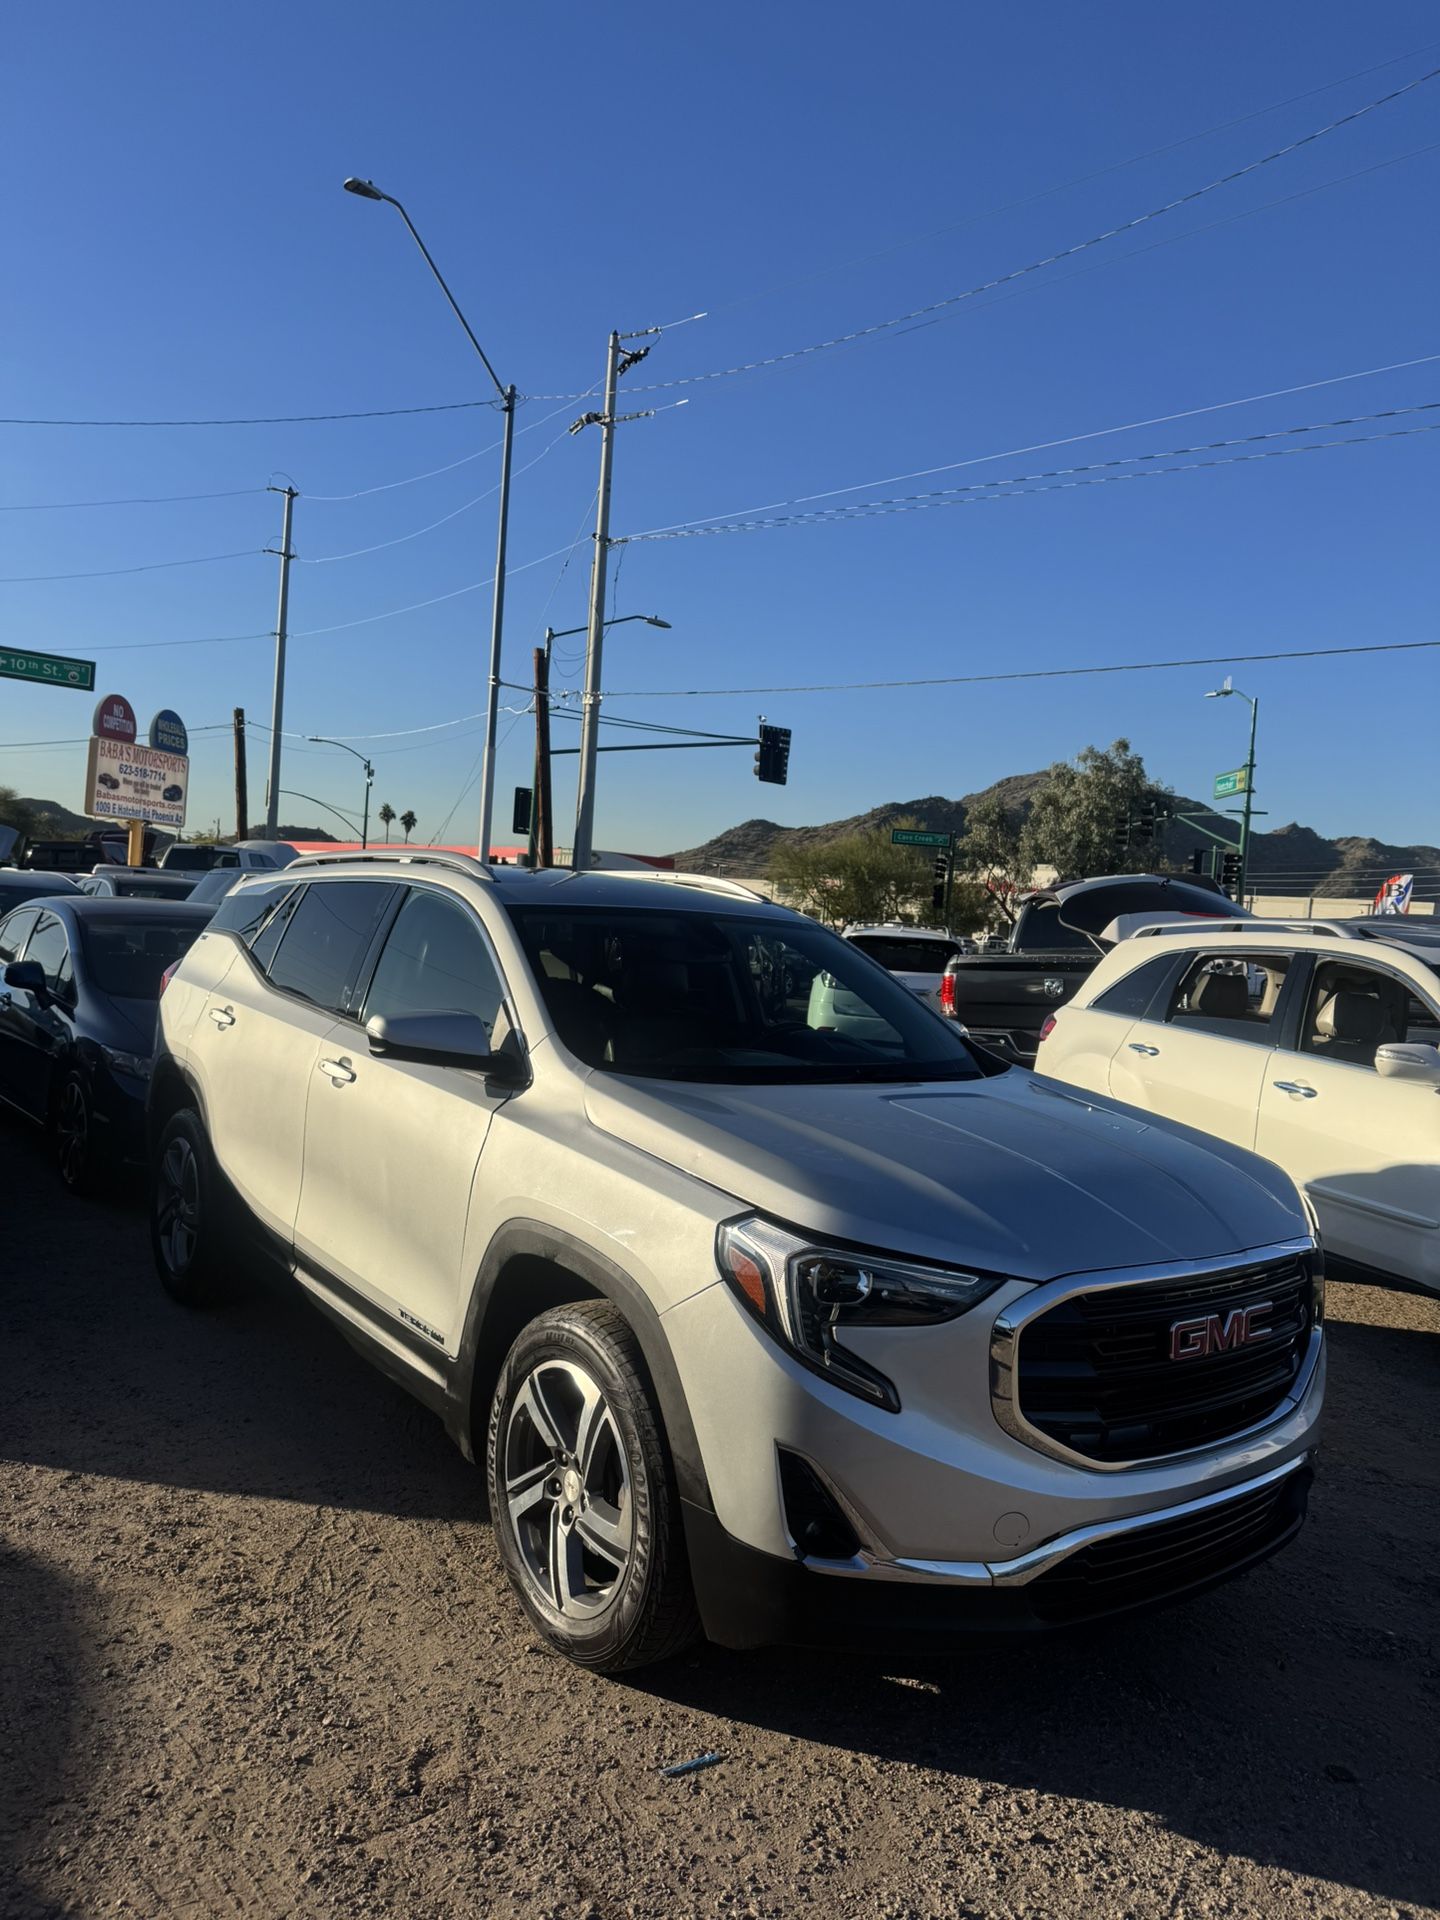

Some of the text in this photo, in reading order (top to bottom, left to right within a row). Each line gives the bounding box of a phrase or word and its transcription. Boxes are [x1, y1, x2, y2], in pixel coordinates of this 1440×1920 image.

[11, 658, 39, 671] 10th
[42, 663, 62, 677] St.
[113, 704, 124, 718] NO
[103, 714, 133, 733] COMPETITION
[158, 731, 185, 749] PRICES
[132, 748, 186, 772] MOTORSPORTS
[119, 764, 166, 781] 623-518-7714
[96, 790, 183, 811] Babasmotorsports.com
[96, 801, 110, 813] 1009
[112, 804, 117, 814] E
[117, 804, 142, 817] Hatcher
[142, 807, 151, 817] Rd
[152, 808, 174, 821] Phoenix
[1169, 1300, 1273, 1361] GMC
